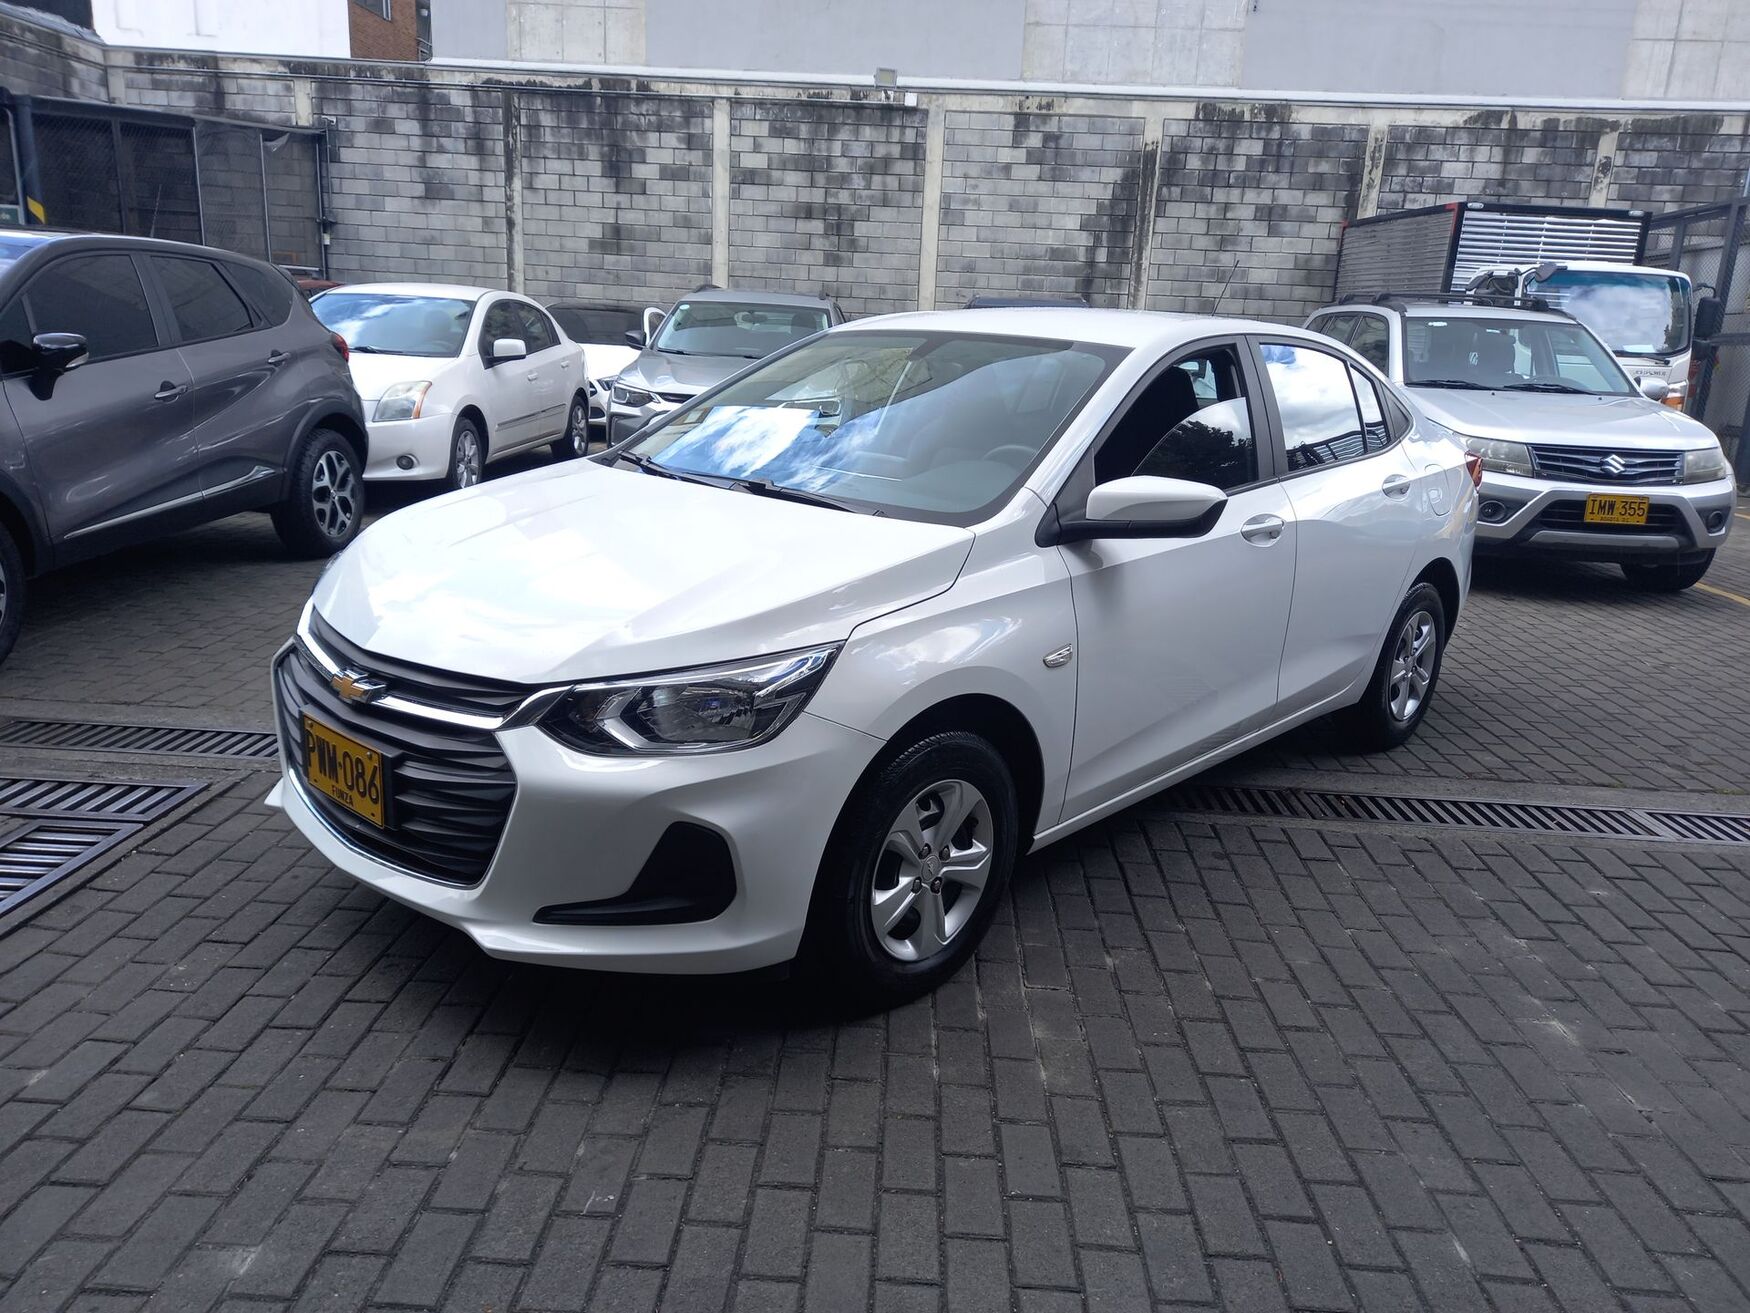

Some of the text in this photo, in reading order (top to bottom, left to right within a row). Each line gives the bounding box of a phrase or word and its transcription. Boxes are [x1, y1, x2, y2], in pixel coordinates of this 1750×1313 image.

[1589, 499, 1646, 517] IMW 355
[331, 784, 354, 807] FUNZA
